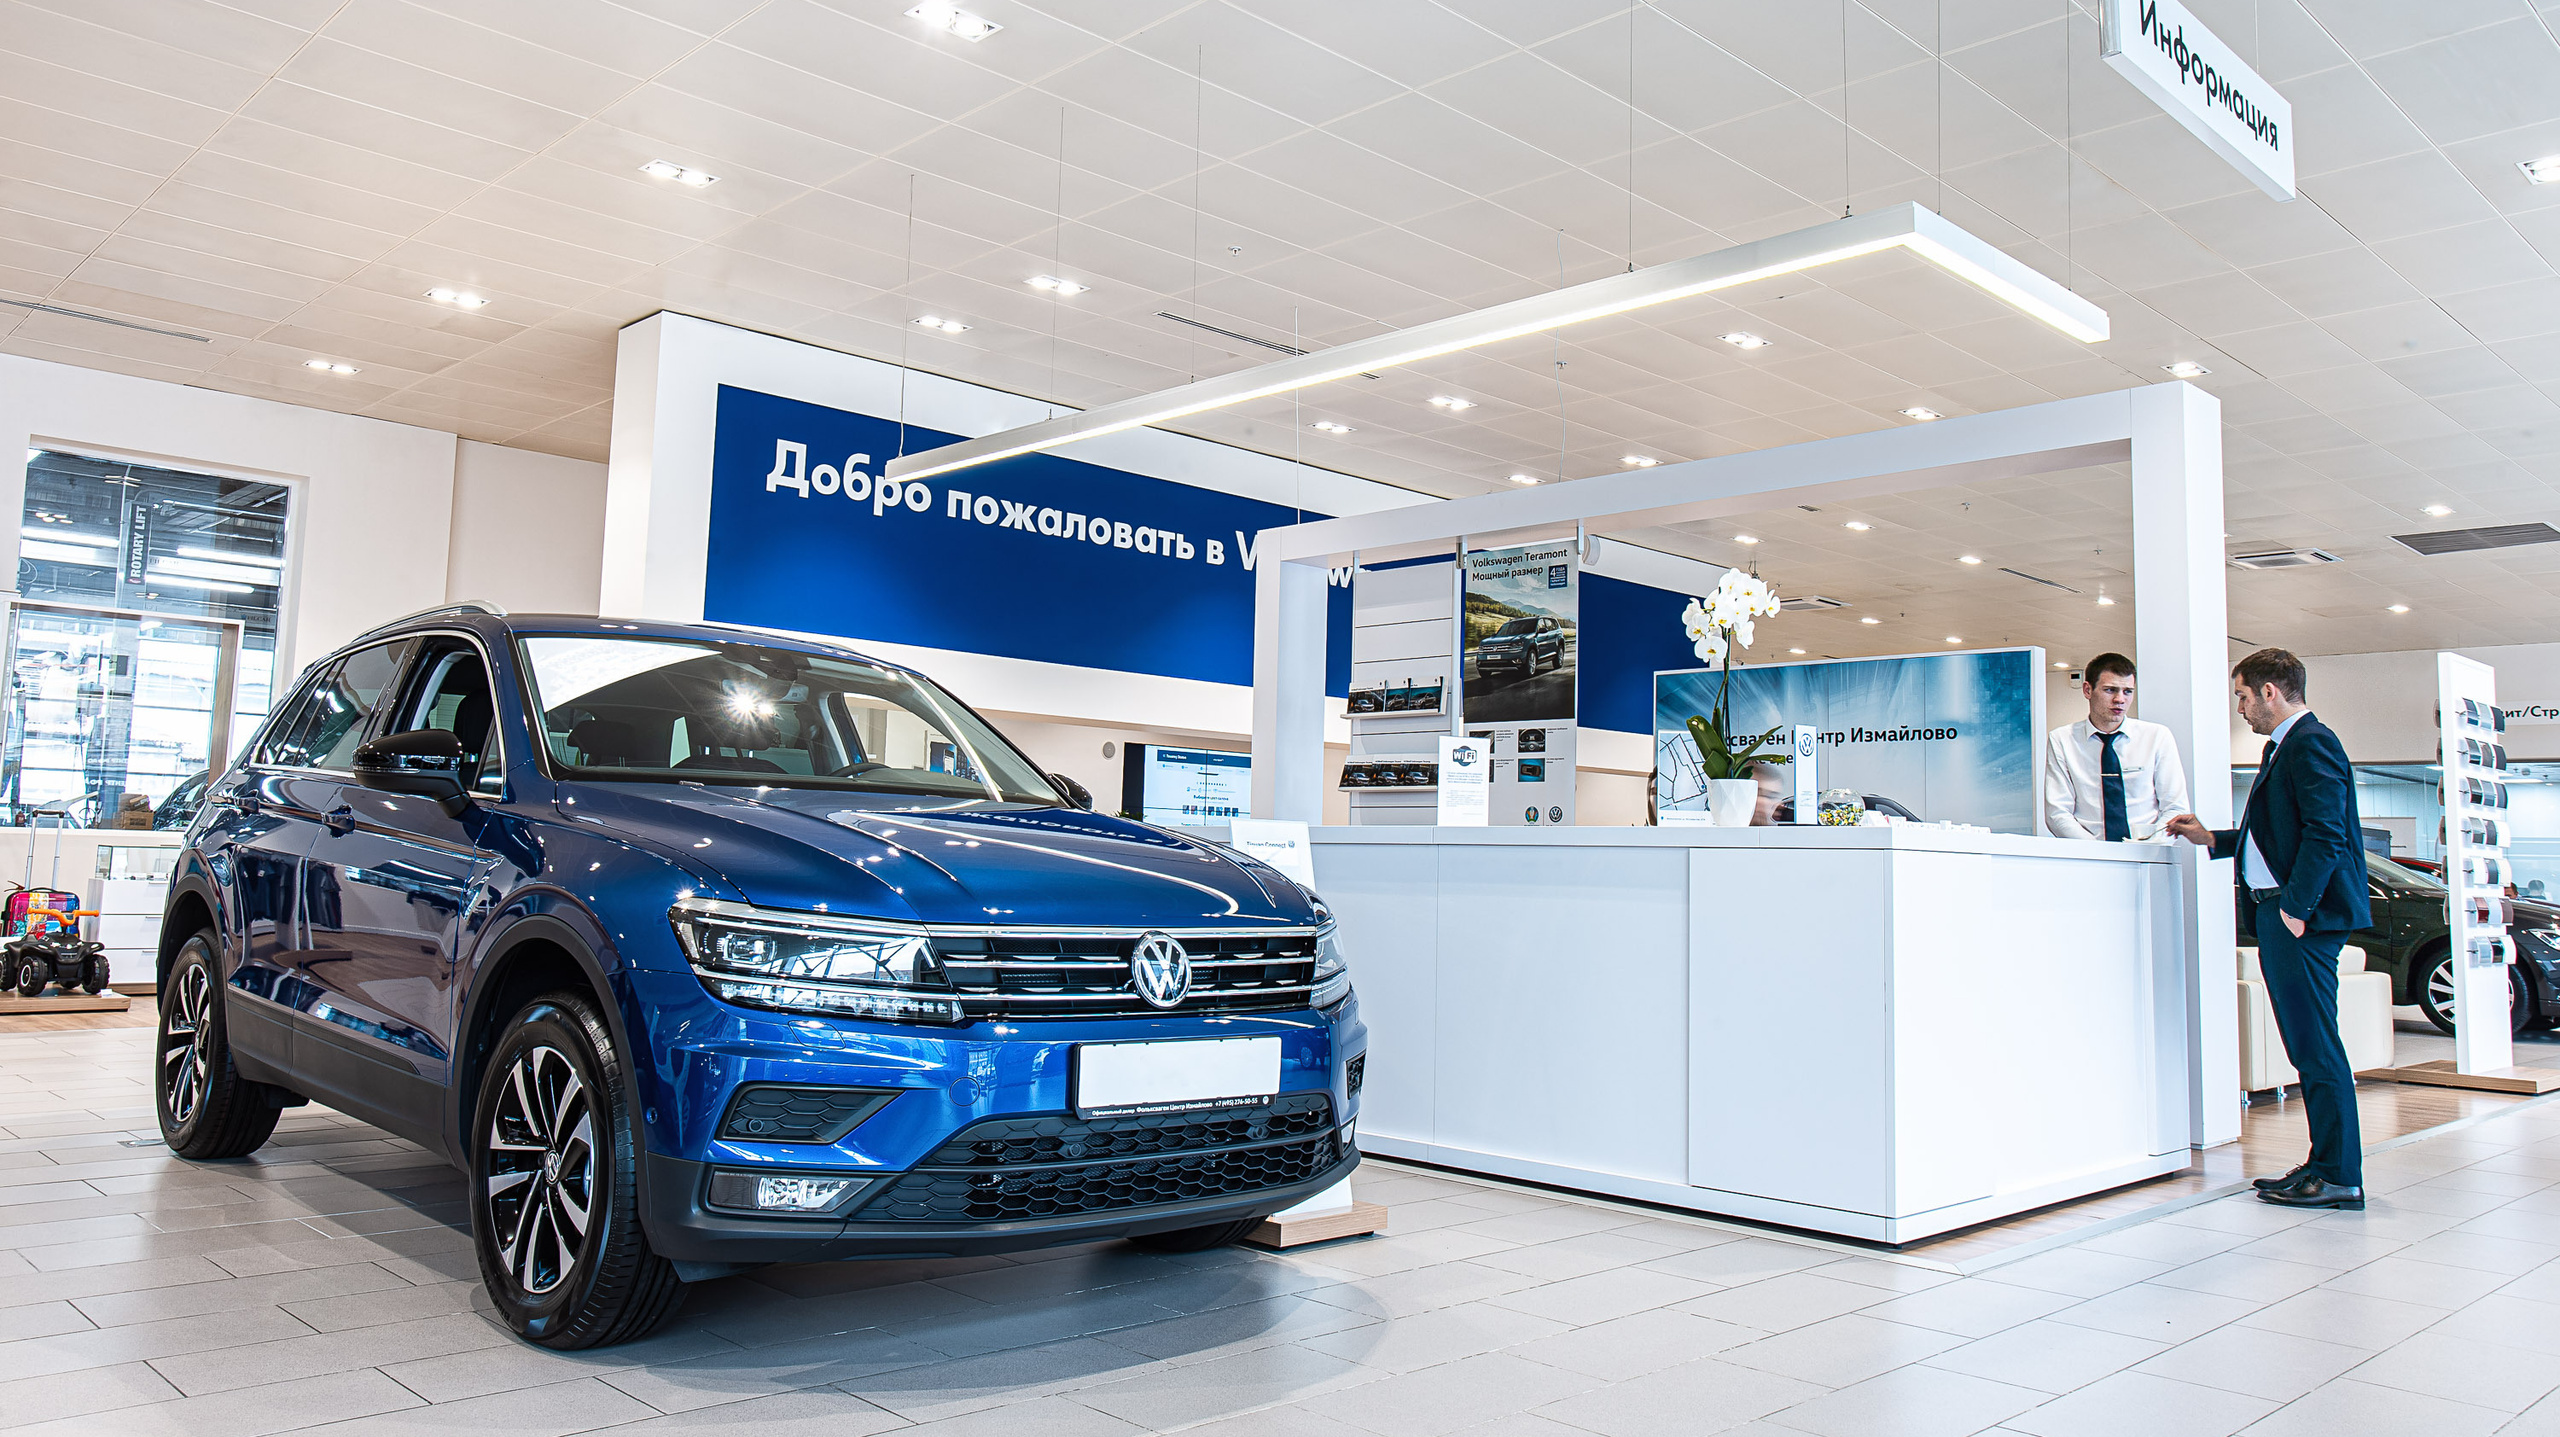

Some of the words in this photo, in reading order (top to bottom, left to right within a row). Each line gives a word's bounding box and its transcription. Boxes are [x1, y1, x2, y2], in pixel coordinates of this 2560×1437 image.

[2139, 0, 2279, 152] Информация
[765, 438, 932, 517] Добро
[946, 489, 1196, 561] пожаловать
[1206, 538, 1226, 566] в
[134, 505, 147, 530] LIFT
[130, 532, 144, 578] ROTARY
[1472, 553, 1523, 568] Volkswagen
[1525, 548, 1568, 562] Teramont
[1472, 569, 1510, 582] Мощный
[1511, 566, 1544, 579] размер
[2503, 705, 2560, 719] ит/Стр
[1850, 725, 1958, 743] Измайлово
